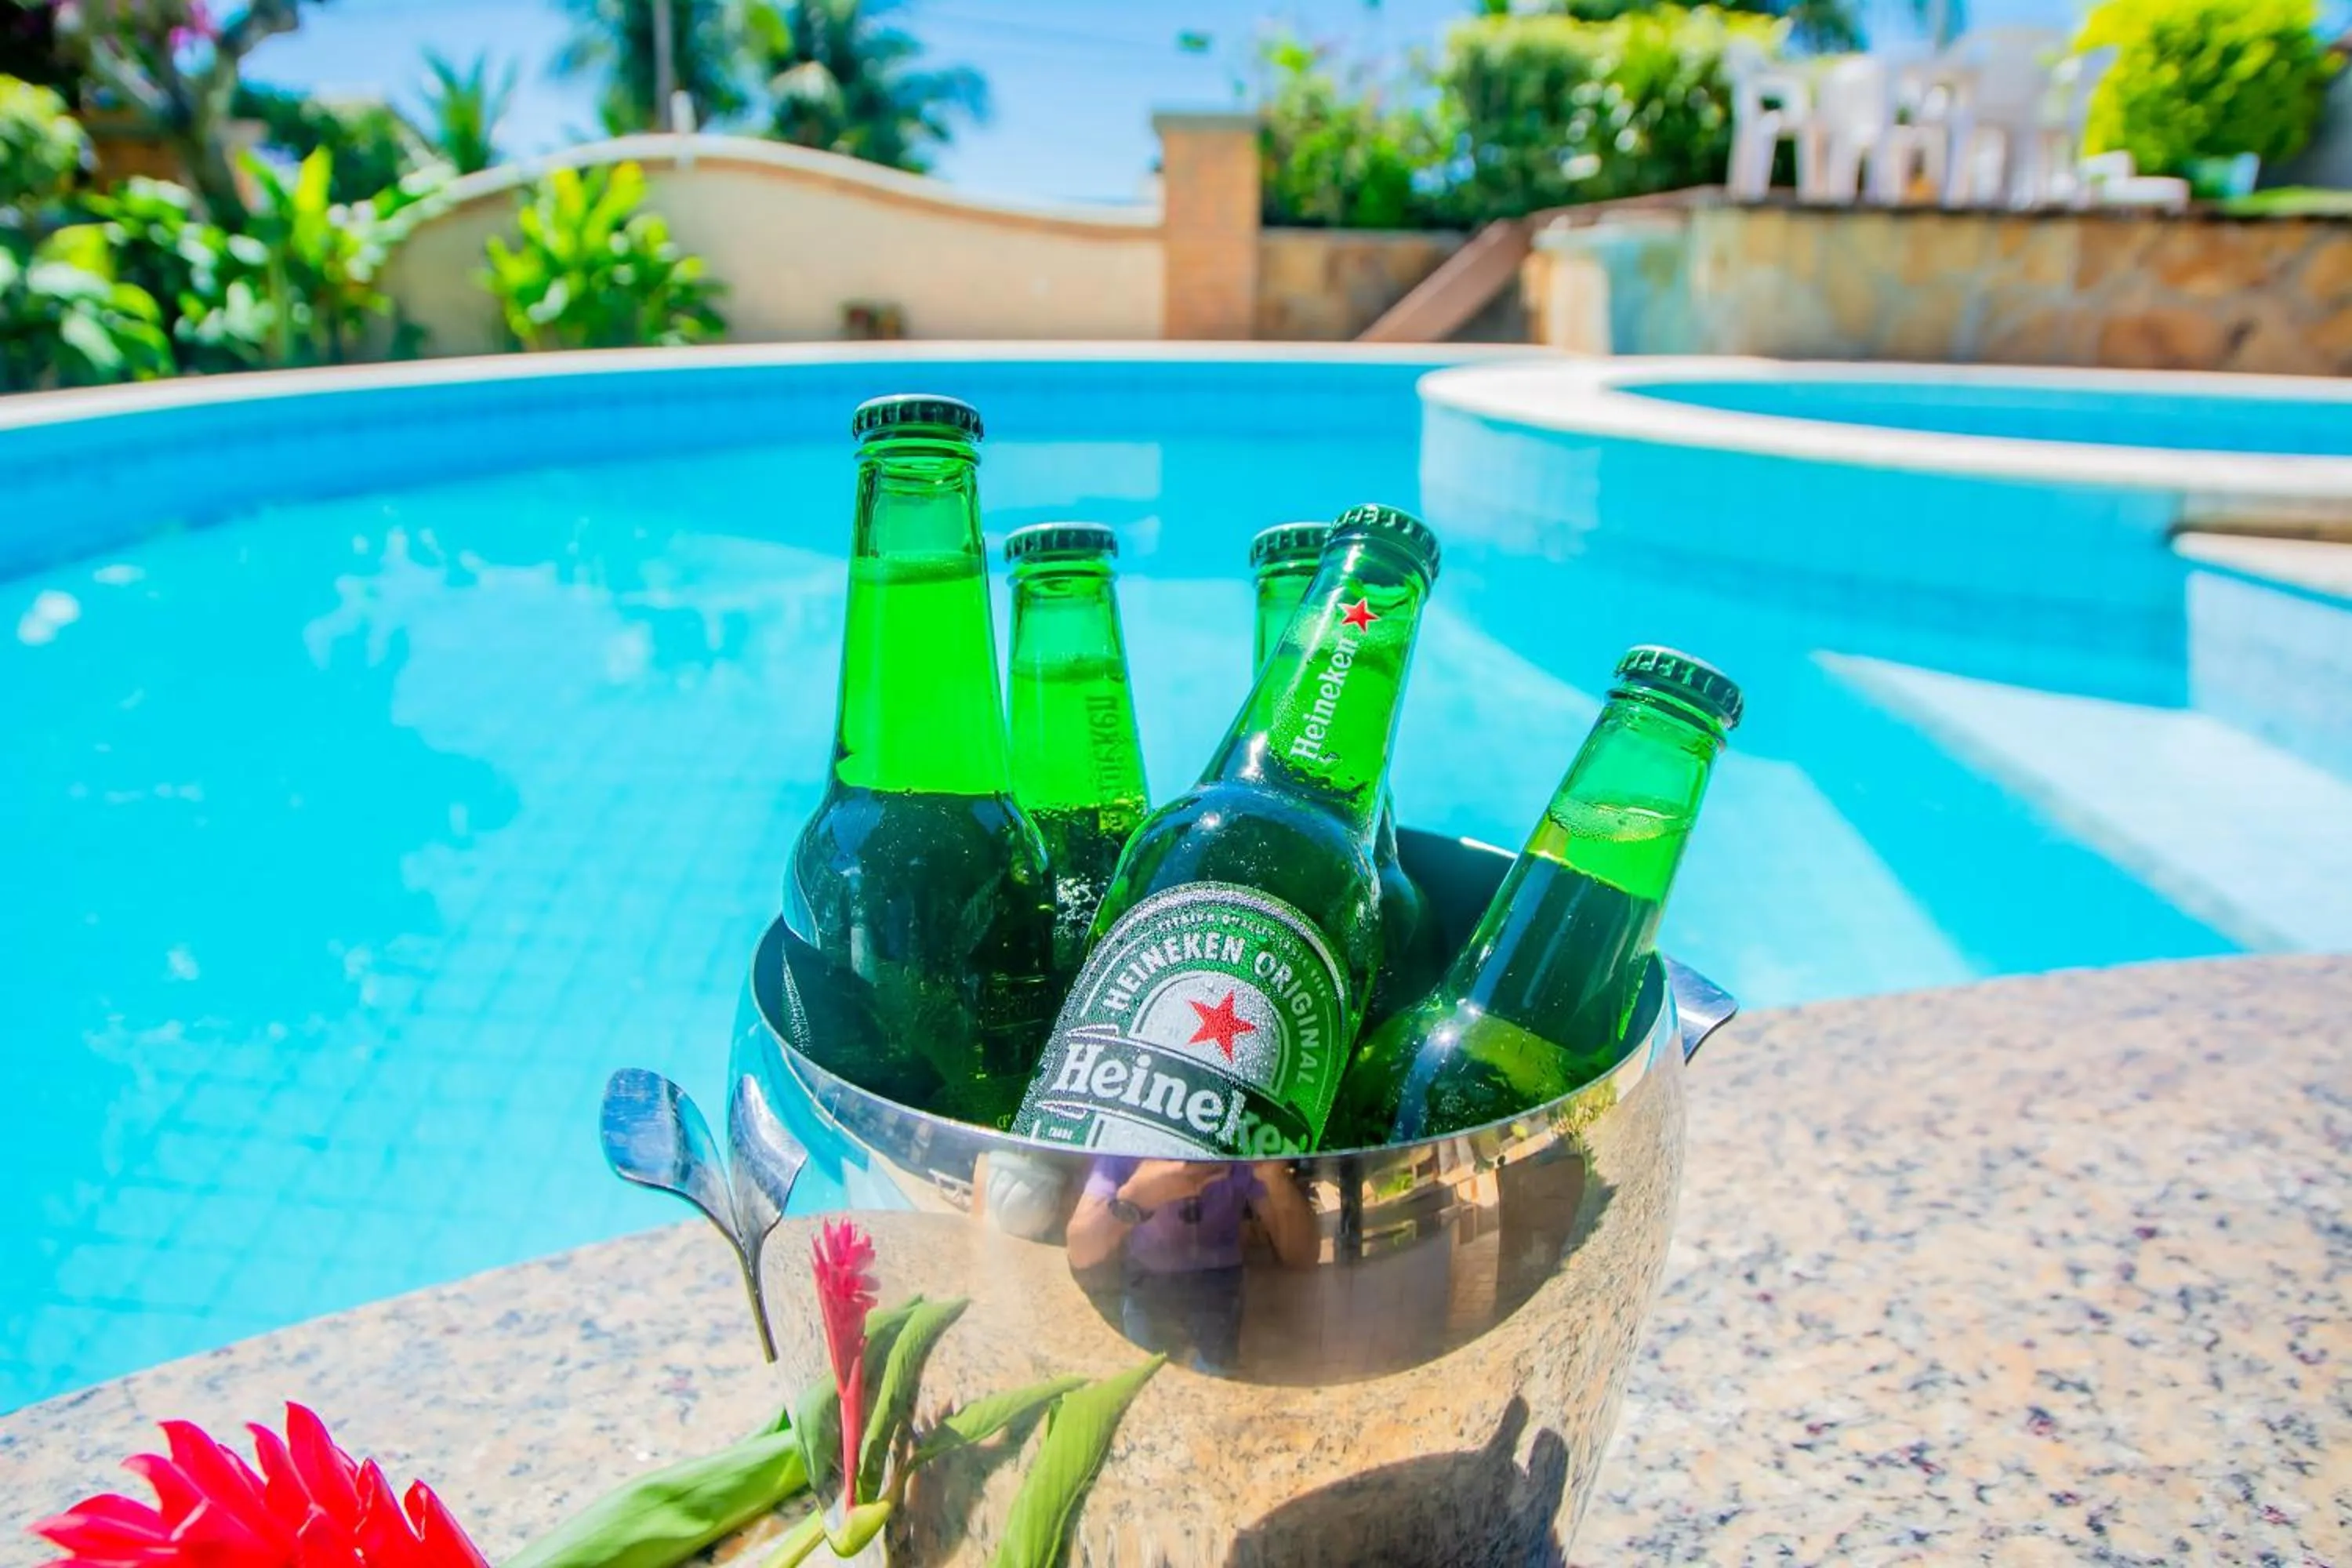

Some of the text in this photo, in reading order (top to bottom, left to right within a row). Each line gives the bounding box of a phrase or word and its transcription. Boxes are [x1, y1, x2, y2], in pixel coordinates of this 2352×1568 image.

[1290, 633, 1359, 762] Heineken
[1102, 931, 1245, 1011] HEINEKEN
[1254, 950, 1321, 1084] ORIGINAL
